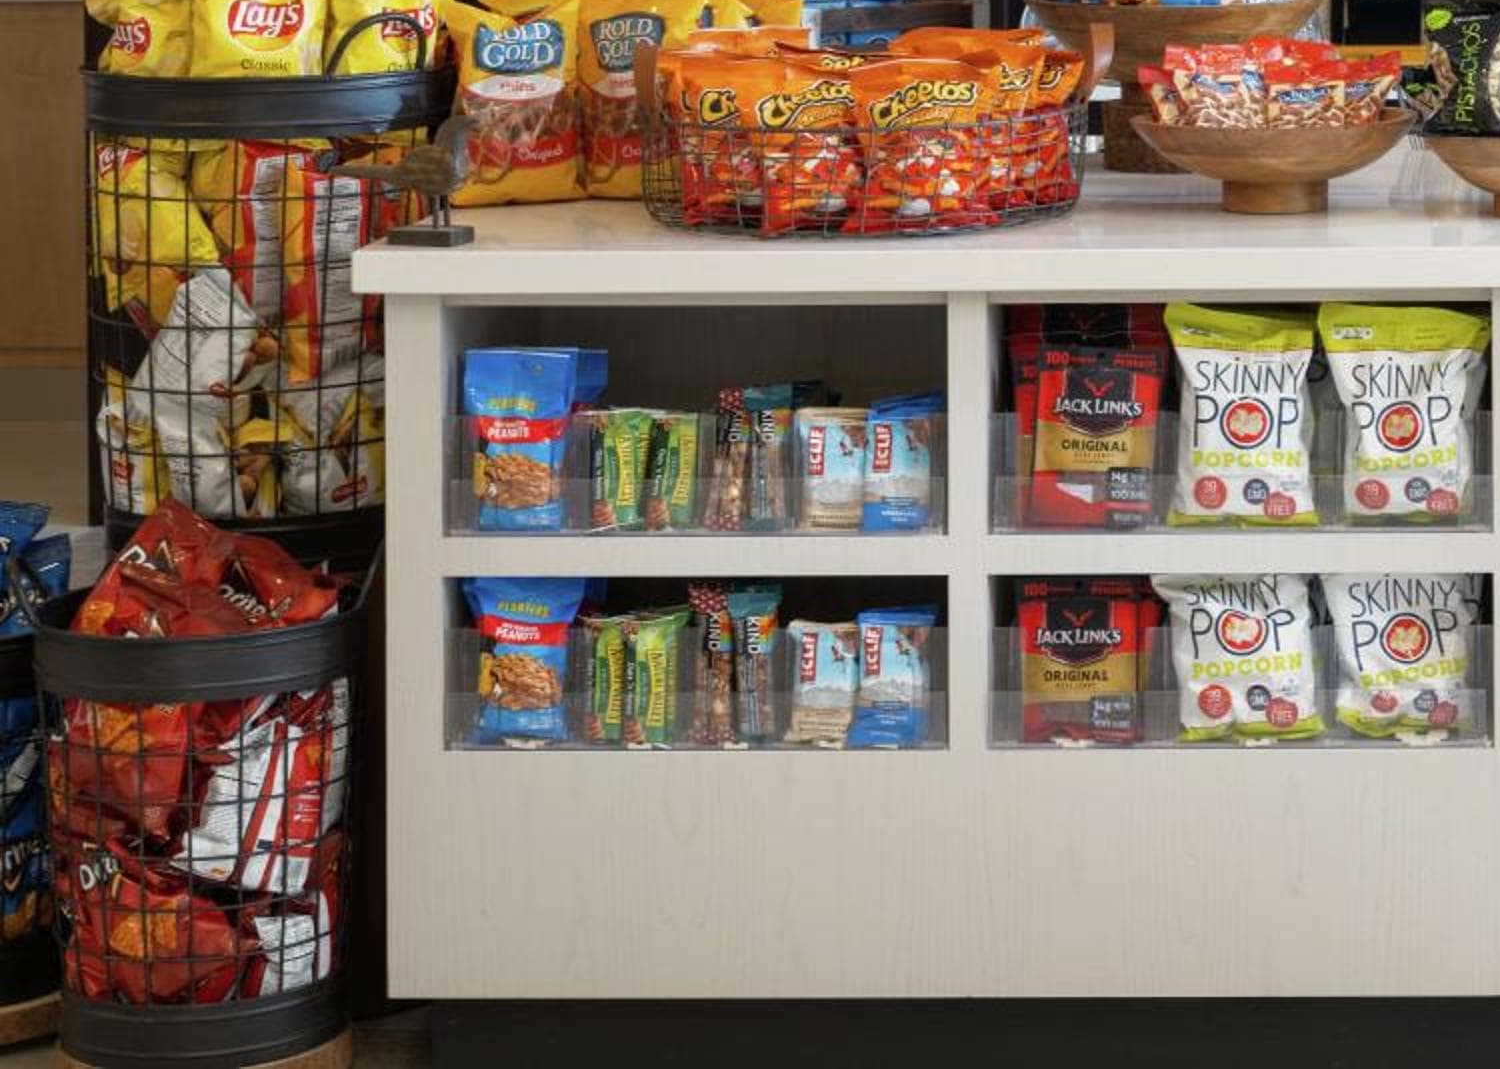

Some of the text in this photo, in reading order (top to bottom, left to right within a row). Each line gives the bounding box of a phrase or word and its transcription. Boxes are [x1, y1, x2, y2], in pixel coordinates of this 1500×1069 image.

[231, 0, 303, 37] Lay's
[600, 18, 655, 39] ROLD
[111, 20, 147, 52] ay's
[240, 58, 292, 72] Classic
[482, 41, 556, 68] GOLD
[755, 78, 855, 128] Cheeto
[868, 81, 979, 131] Cheetos
[1194, 356, 1306, 394] SKINNY
[1351, 356, 1450, 399] SKINNY
[1055, 398, 1094, 415] JACK
[488, 427, 529, 439] PEANUTS
[1192, 395, 1300, 451] POP
[1350, 398, 1453, 454] POP
[1061, 439, 1129, 452] ORIGINAL
[1192, 450, 1302, 469] POPCORN
[1357, 444, 1457, 473] POPCORN
[1184, 574, 1284, 610] SKINNY
[1348, 574, 1457, 619] SKINNY
[496, 626, 541, 642] PEANUTS
[708, 612, 721, 651] KIND
[746, 616, 761, 654] KIND
[1034, 628, 1074, 646] JACK
[1188, 608, 1296, 660] POP
[1351, 608, 1458, 673] POP
[1043, 670, 1109, 682] ORIGINAL
[1192, 651, 1303, 680] POPCORN
[1360, 656, 1467, 688] POPCORN
